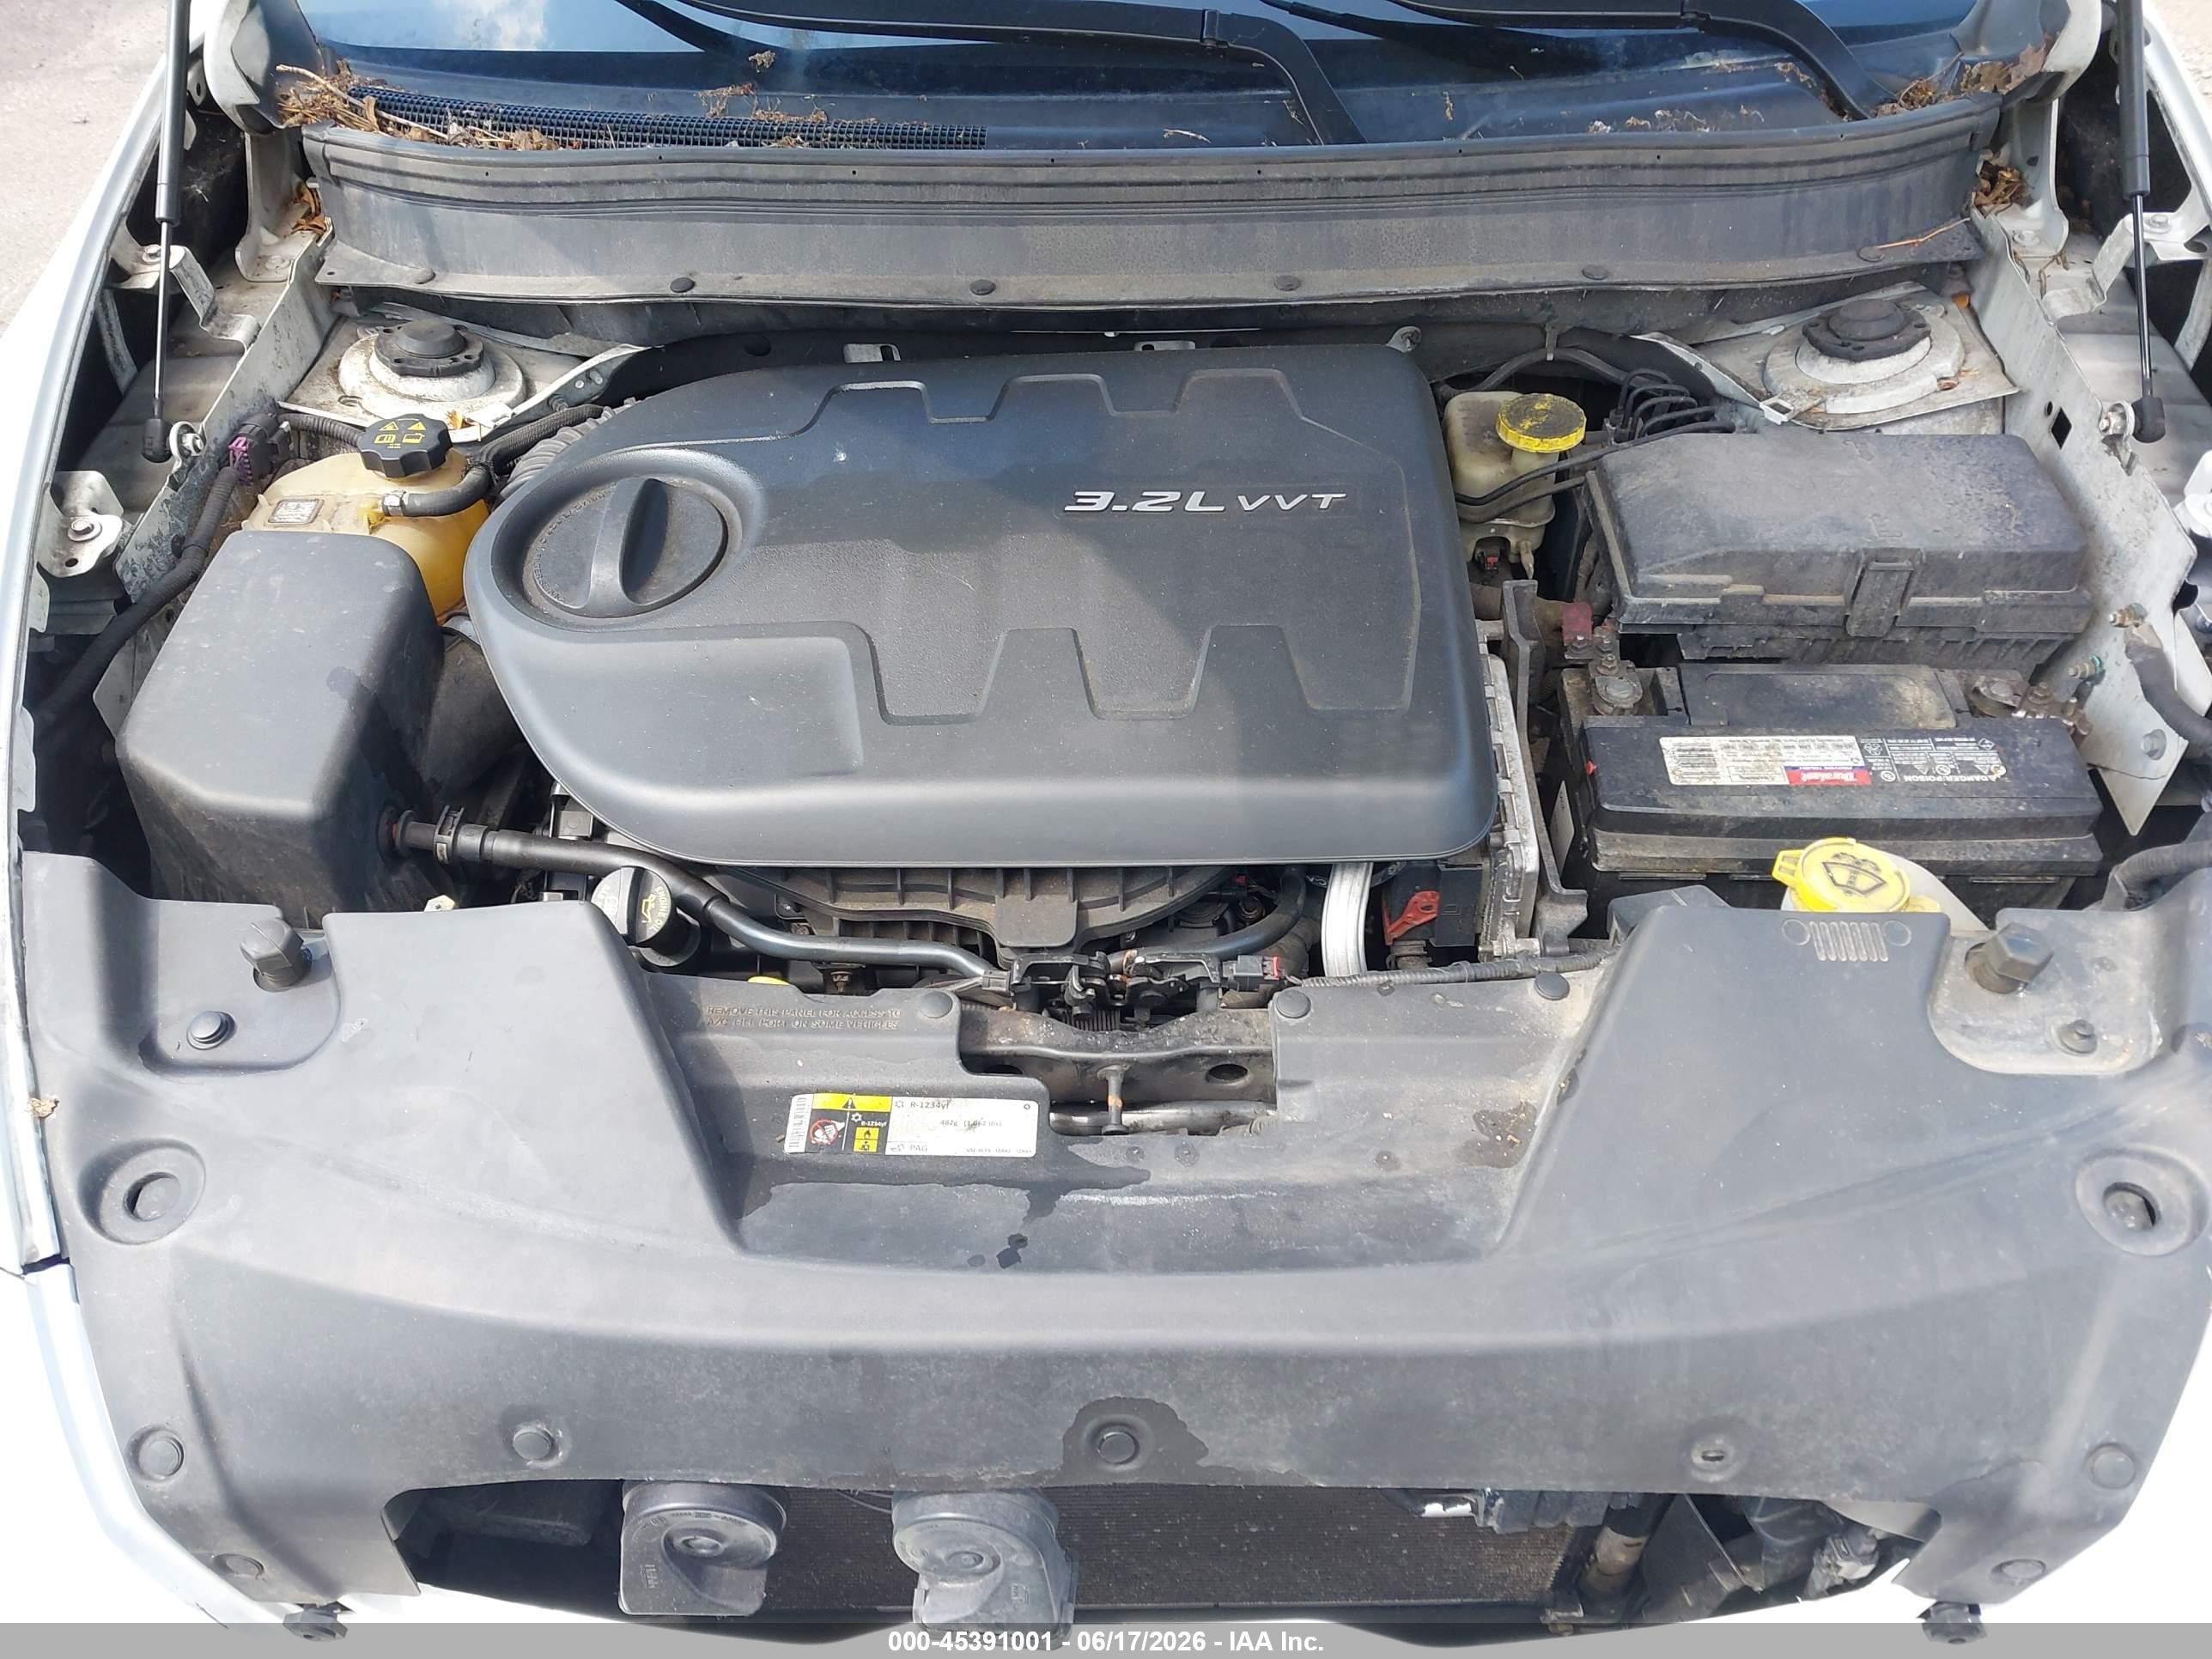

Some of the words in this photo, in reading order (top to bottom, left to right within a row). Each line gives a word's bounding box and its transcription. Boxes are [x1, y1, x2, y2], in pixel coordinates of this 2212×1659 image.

[1064, 490, 1225, 512] 3.2L
[1237, 492, 1347, 512] VVT
[1800, 771, 1858, 782] Duralast
[654, 885, 668, 918] ENGINE
[649, 919, 663, 933] OIL
[706, 1006, 753, 1016] REMOVE
[755, 1007, 780, 1017] THIS
[781, 1008, 816, 1018] PANEL
[818, 1008, 841, 1018] FOR
[887, 1009, 902, 1018] TO
[706, 1017, 729, 1026] A/C
[811, 1019, 843, 1029] SOME
[910, 1100, 950, 1110] R-1234yf
[910, 1144, 927, 1152] PAG
